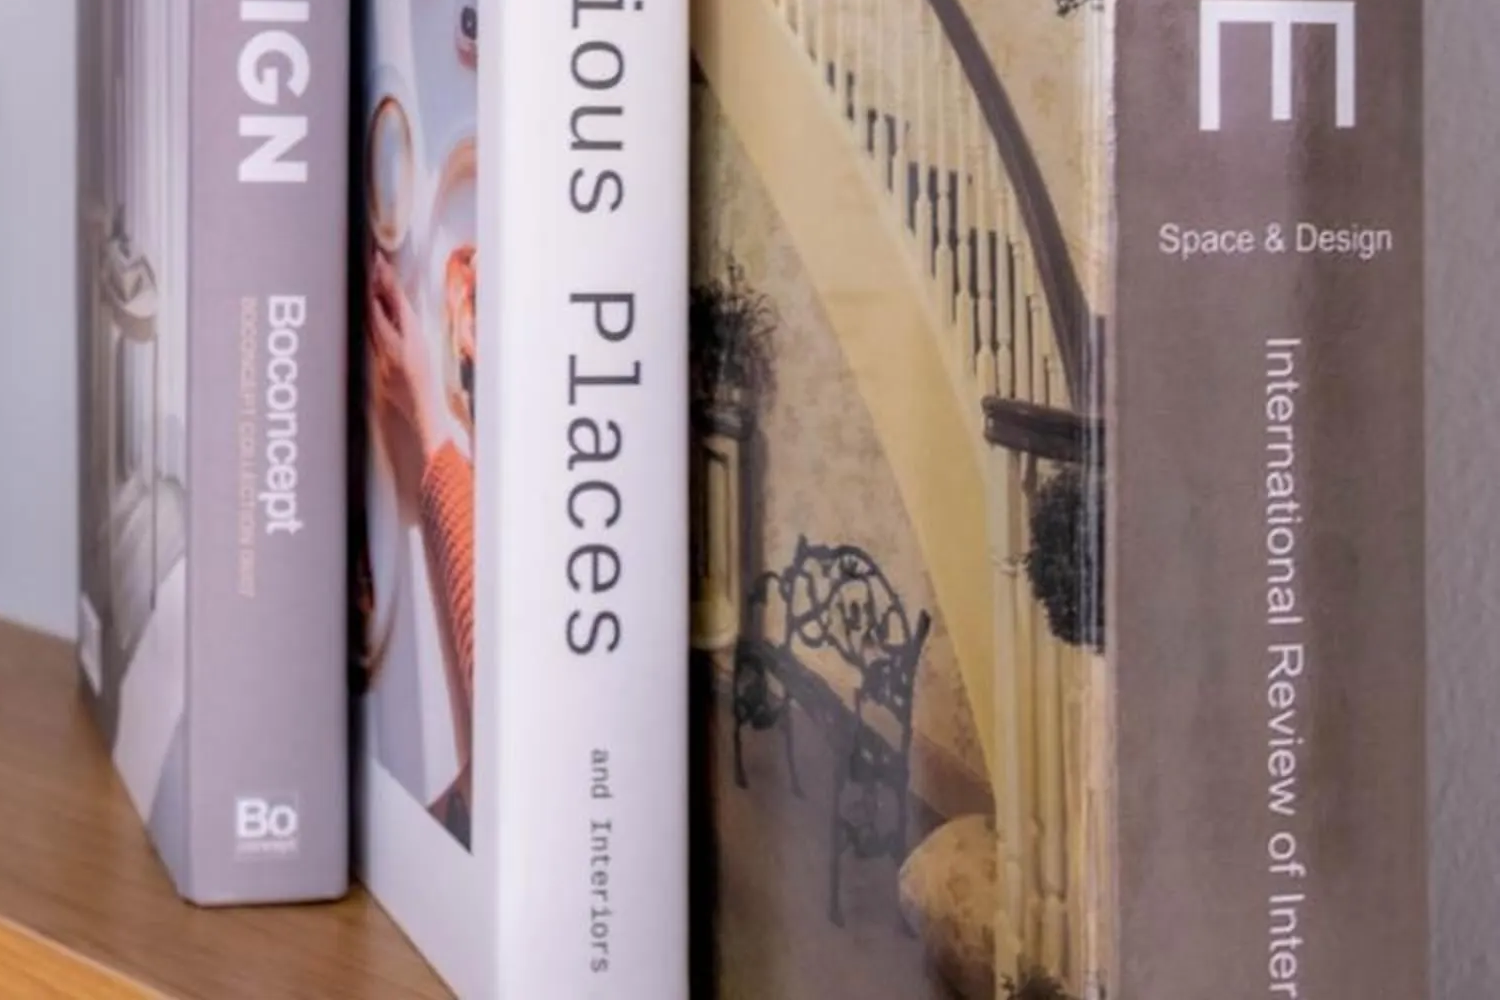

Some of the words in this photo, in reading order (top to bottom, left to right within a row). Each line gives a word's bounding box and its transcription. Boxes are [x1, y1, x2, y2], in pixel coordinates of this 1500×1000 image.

[1158, 222, 1255, 260] Space
[1264, 222, 1286, 254] &
[1296, 222, 1393, 260] Design
[565, 292, 643, 657] Places
[1266, 337, 1304, 625] International
[589, 748, 610, 800] and
[1267, 642, 1305, 816] Review
[589, 819, 613, 975] Interiors
[1267, 832, 1306, 876] of
[1268, 894, 1306, 999] Inter
